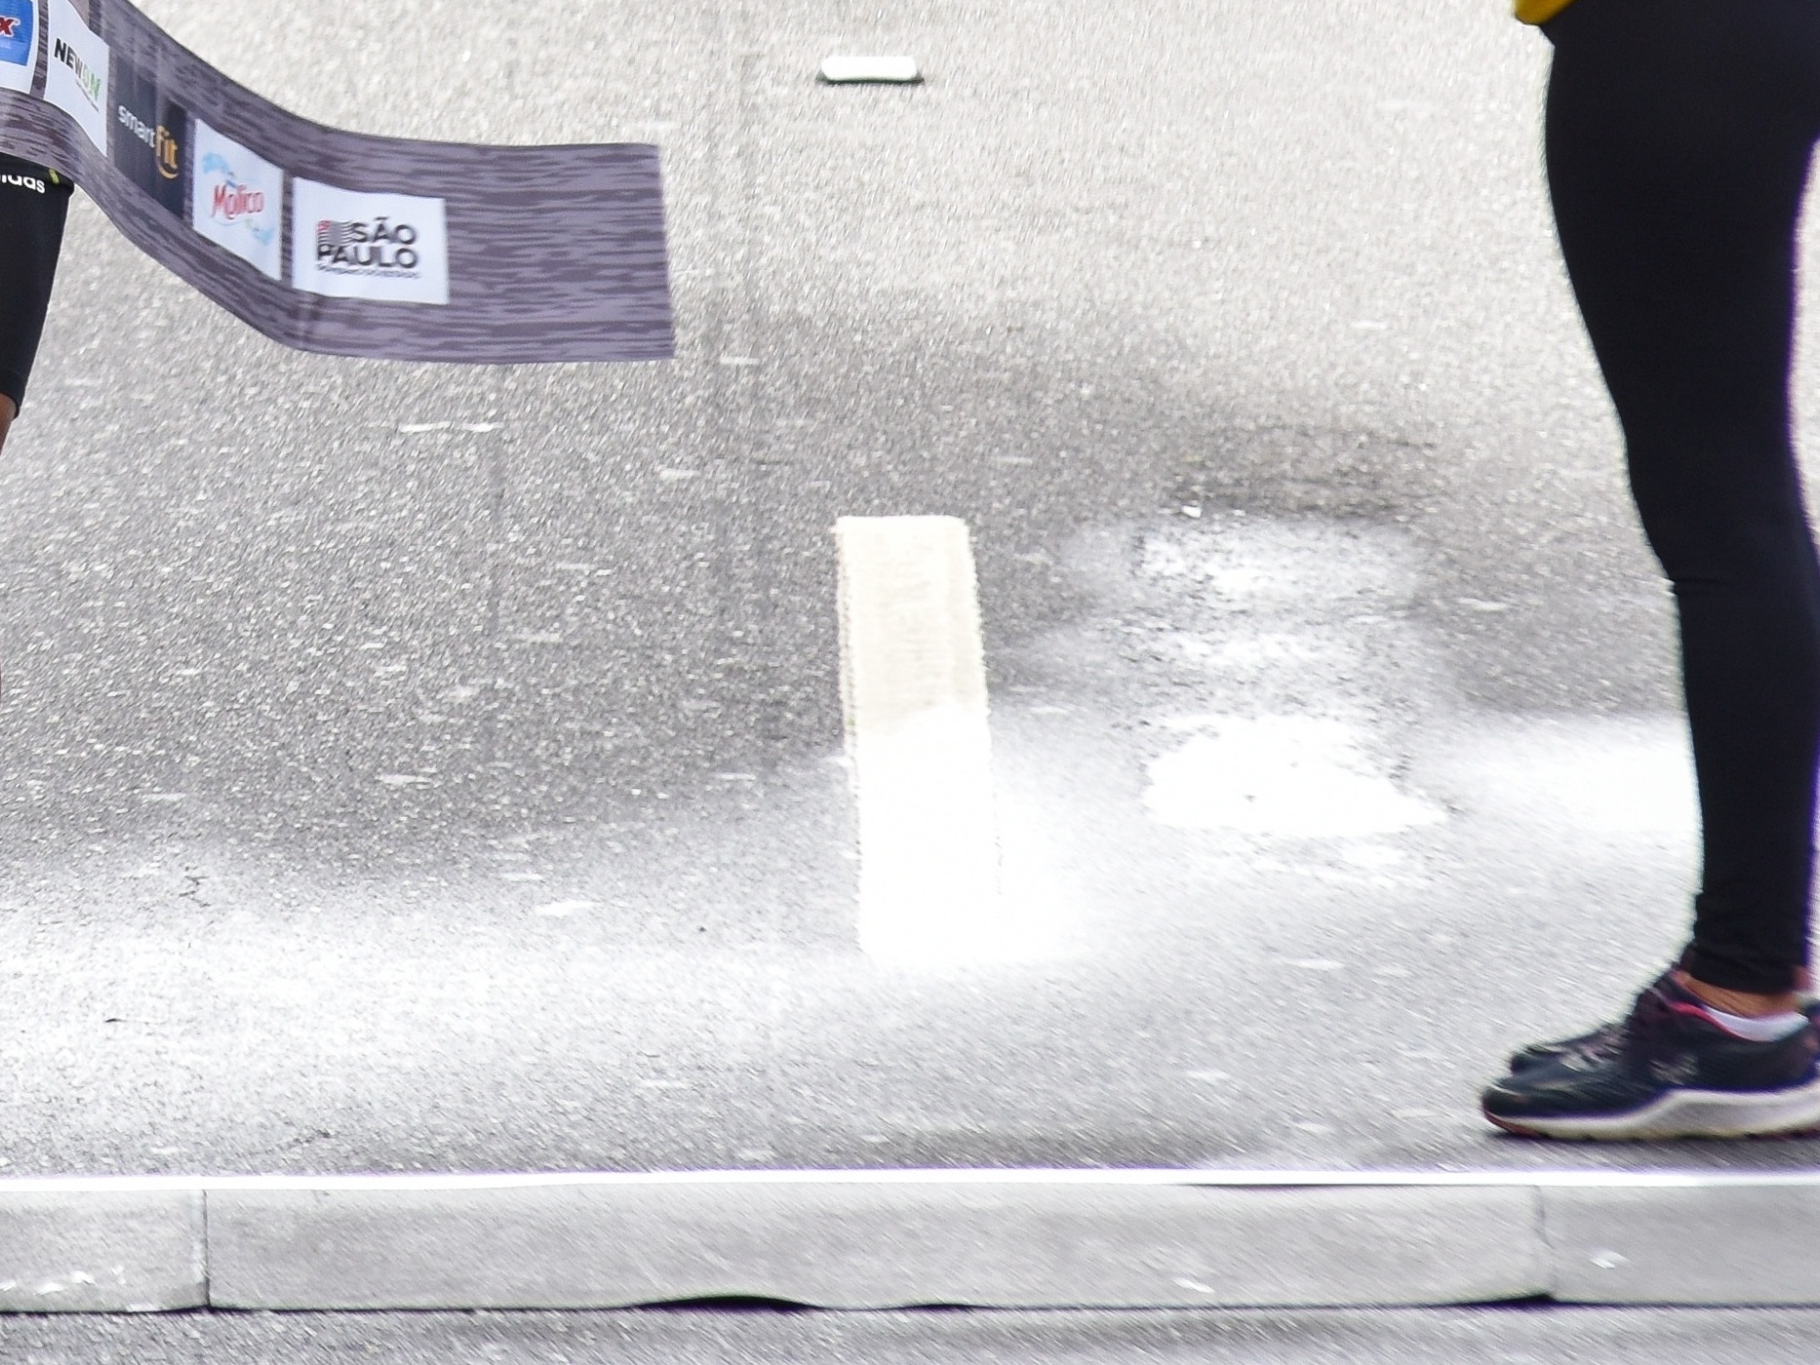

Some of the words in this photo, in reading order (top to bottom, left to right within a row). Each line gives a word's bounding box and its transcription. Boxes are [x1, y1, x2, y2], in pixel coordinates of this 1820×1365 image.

[211, 185, 265, 220] Molico
[352, 216, 417, 245] SÃO
[317, 243, 419, 269] PAULO
